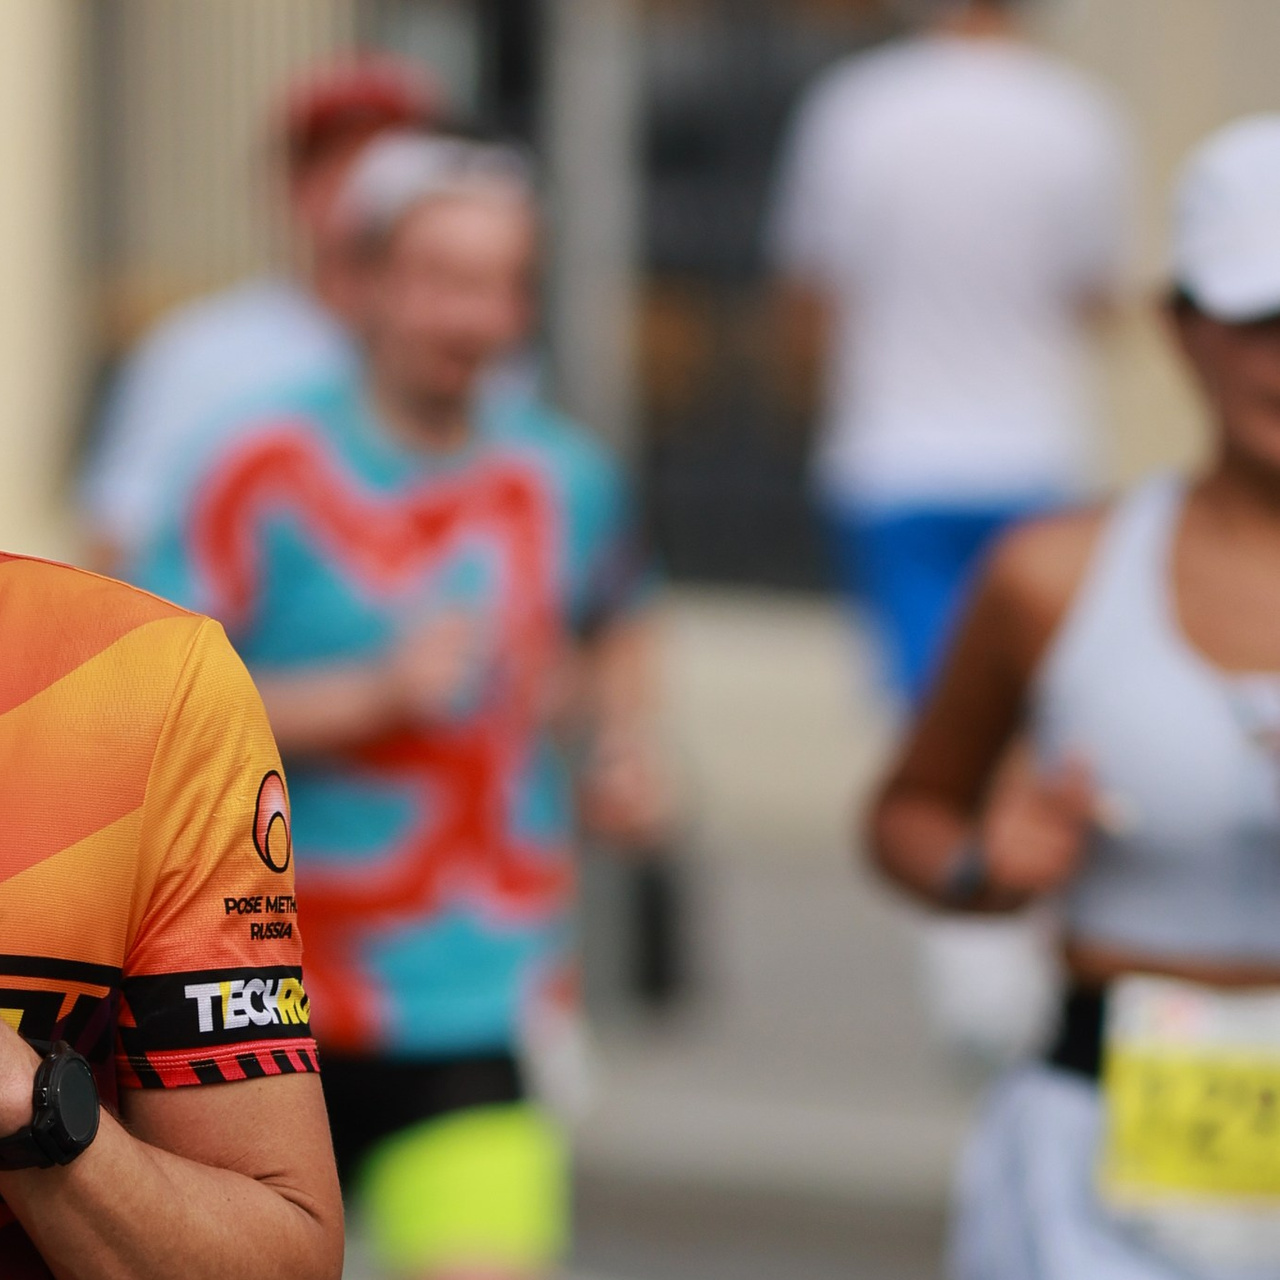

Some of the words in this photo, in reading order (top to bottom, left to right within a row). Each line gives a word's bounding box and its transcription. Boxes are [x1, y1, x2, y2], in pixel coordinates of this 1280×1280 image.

[224, 896, 263, 914] POSE
[265, 896, 297, 914] METH
[250, 922, 292, 940] RUSSIA
[184, 978, 311, 1033] TECHRU
